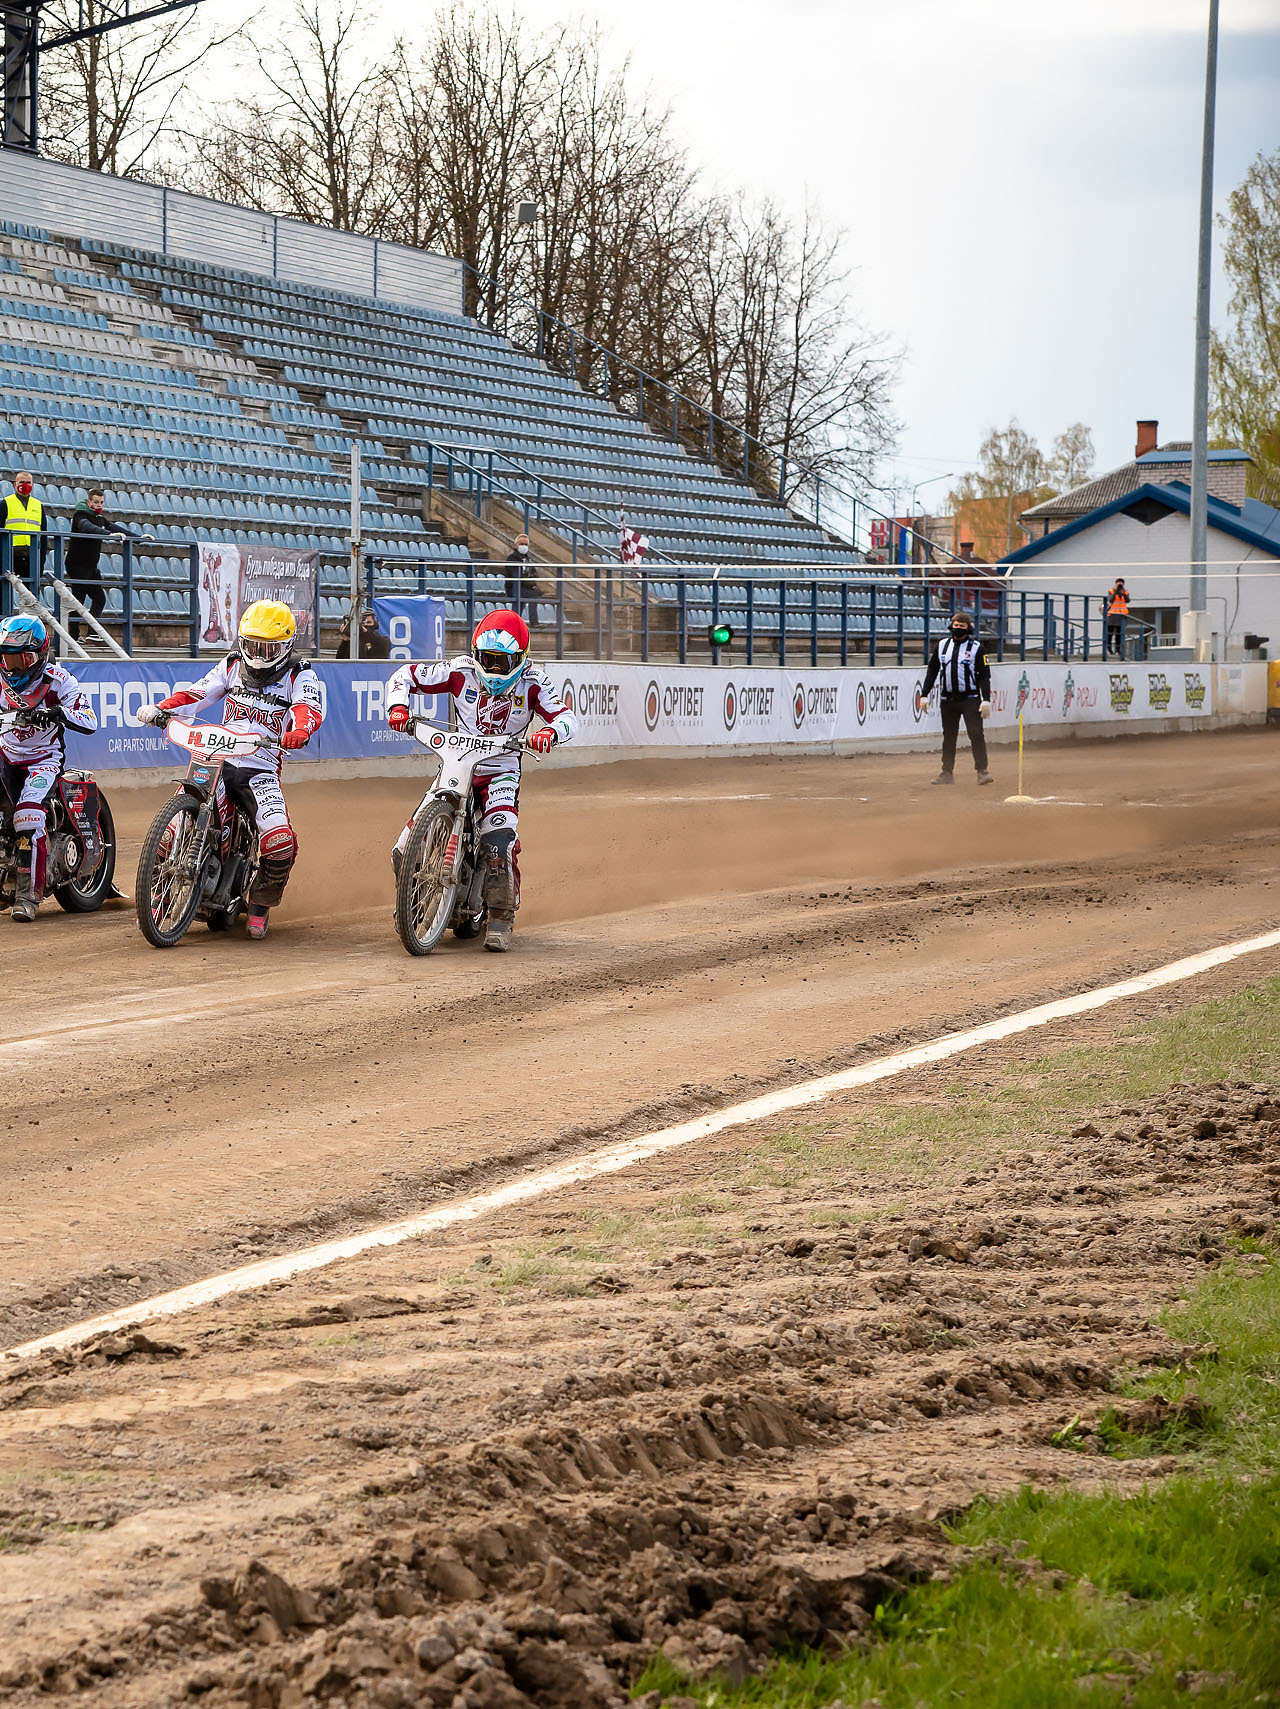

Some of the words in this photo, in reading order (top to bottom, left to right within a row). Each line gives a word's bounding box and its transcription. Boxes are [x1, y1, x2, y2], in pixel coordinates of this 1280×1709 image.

[578, 683, 620, 715] OPTIBET
[663, 686, 704, 717] OPTIBET
[740, 687, 775, 716] OPTIBET
[807, 687, 838, 715] OPTIBET
[869, 686, 899, 712] OPTIBET
[108, 739, 121, 752] CAR
[123, 738, 144, 752] PARTS
[145, 737, 169, 751] ONLINE
[188, 731, 206, 748] HL
[207, 734, 237, 750] BAU
[371, 730, 383, 742] CAR
[448, 736, 495, 751] OPTIBET
